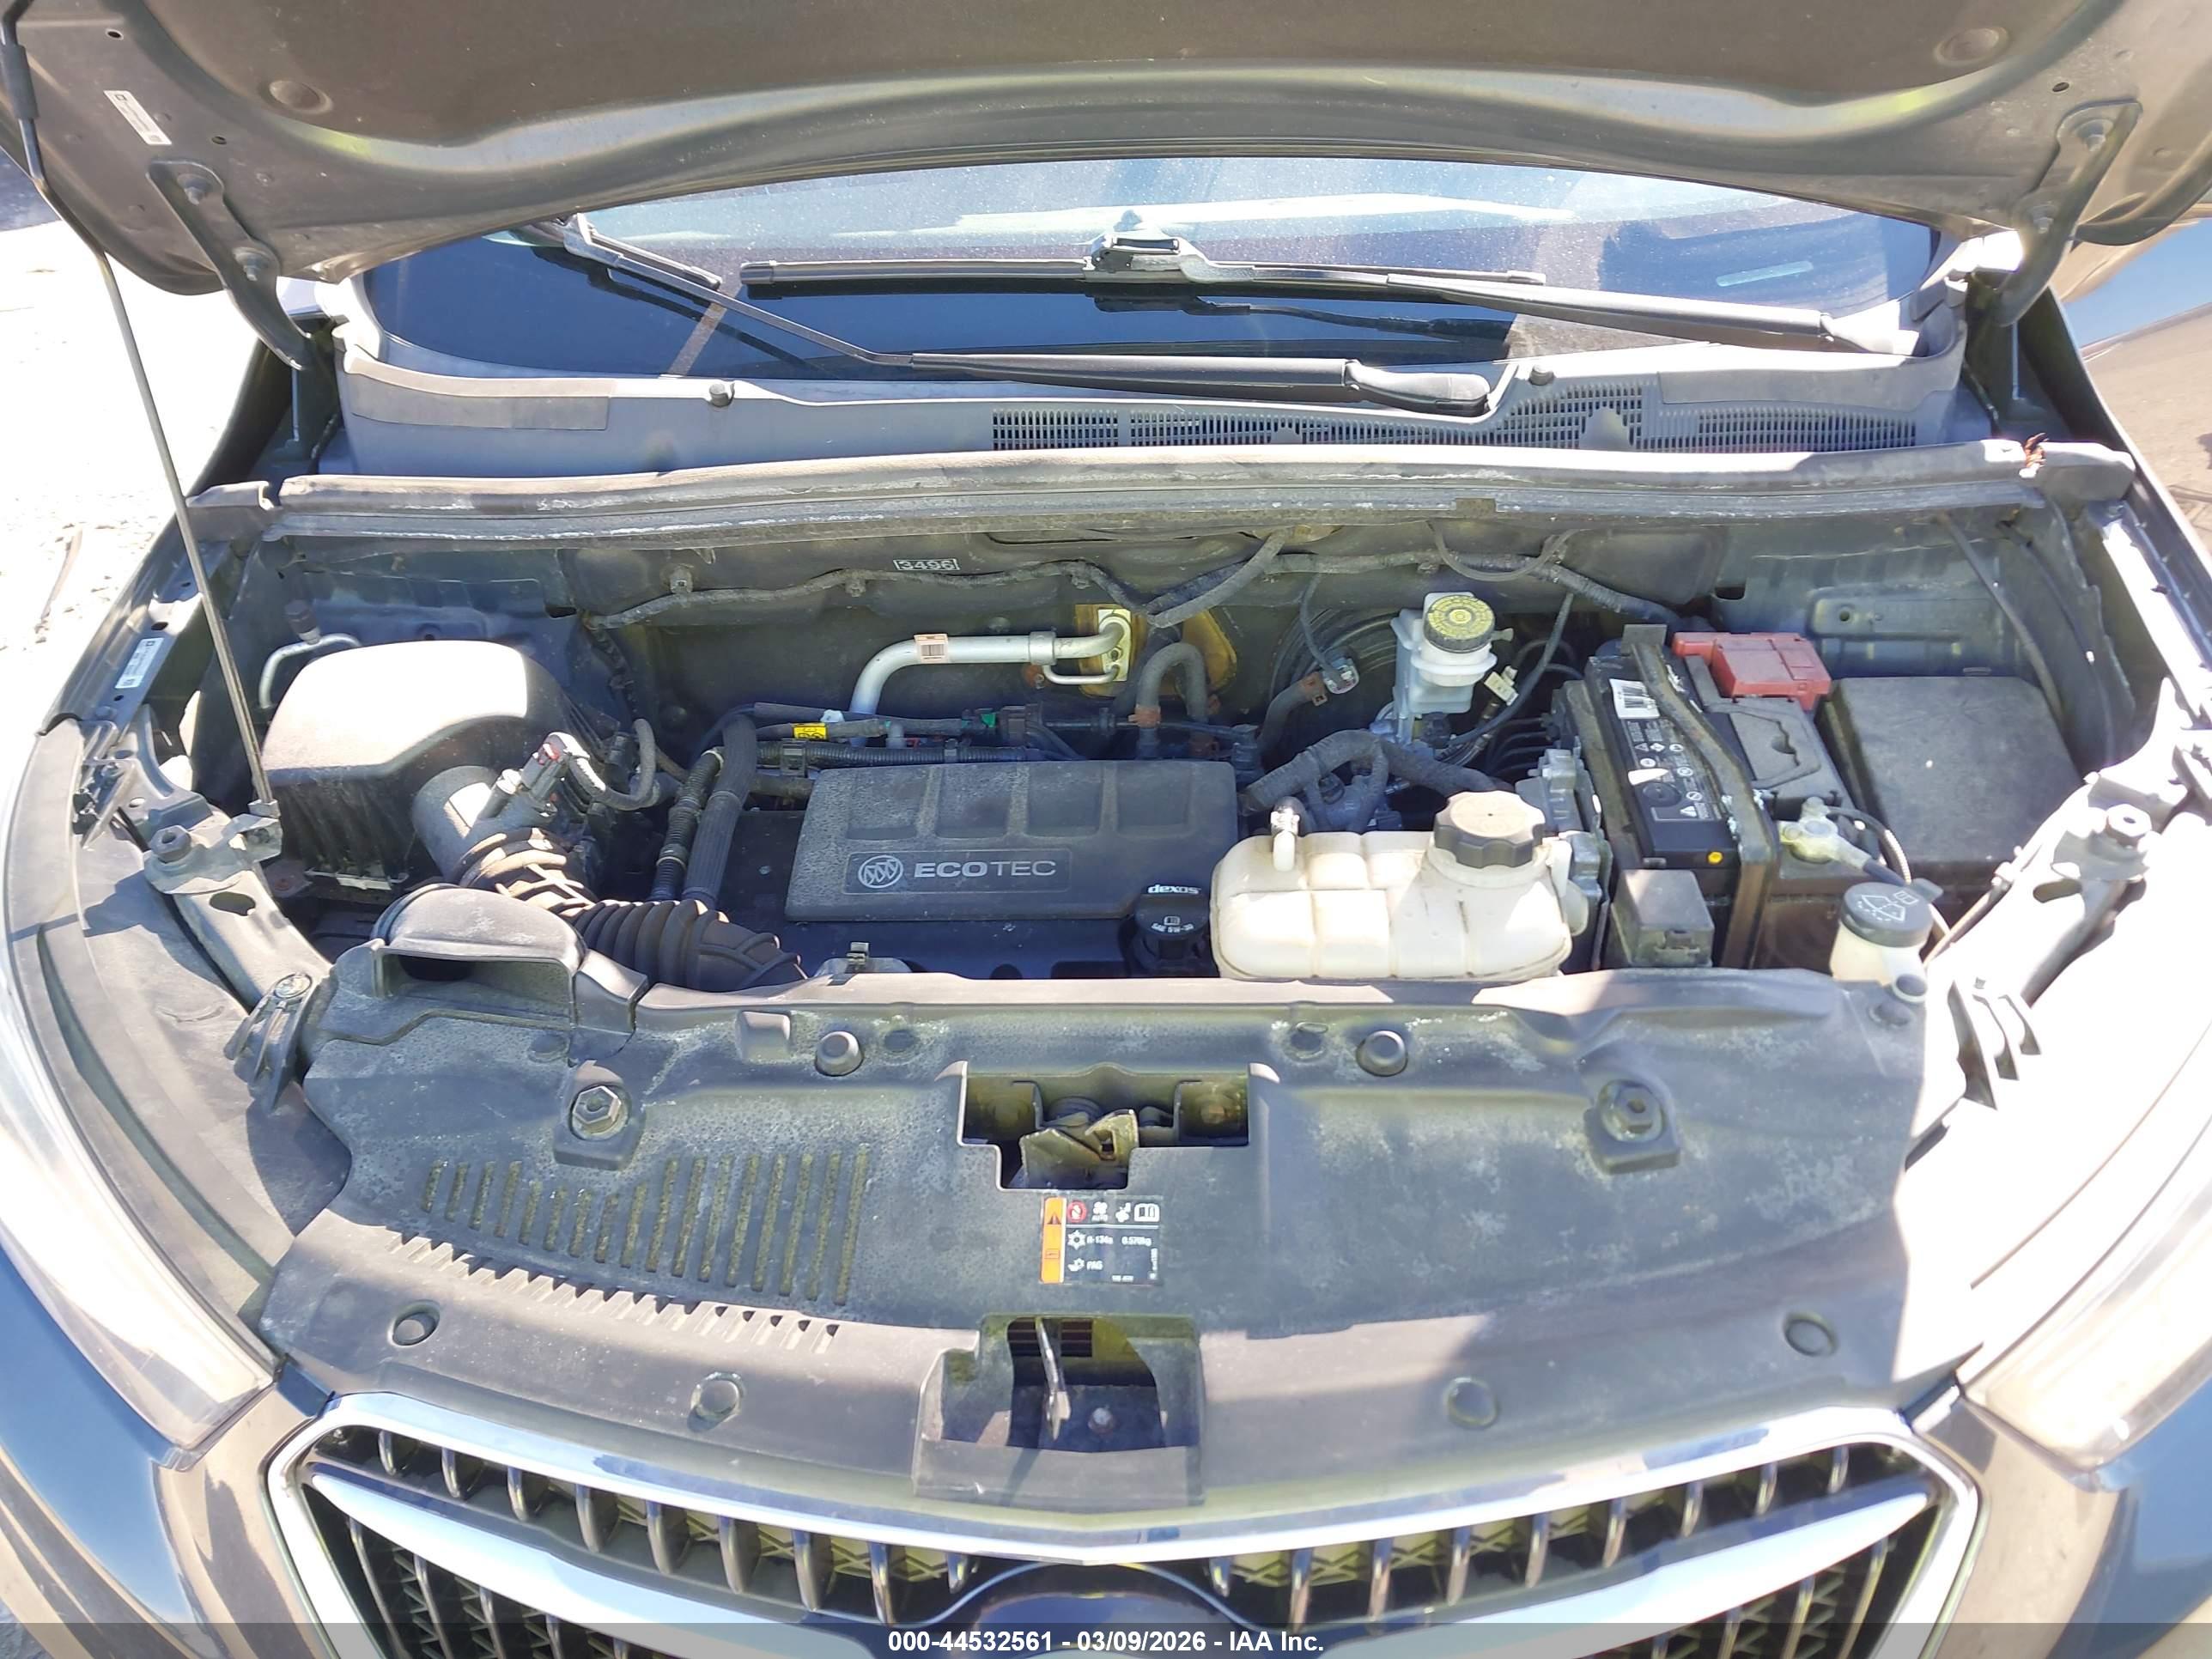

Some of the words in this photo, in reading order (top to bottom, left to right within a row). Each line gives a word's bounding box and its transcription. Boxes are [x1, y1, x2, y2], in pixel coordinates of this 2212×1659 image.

[897, 560, 956, 570] 3496
[914, 860, 1056, 878] ECOTEC
[1147, 884, 1200, 894] dexos
